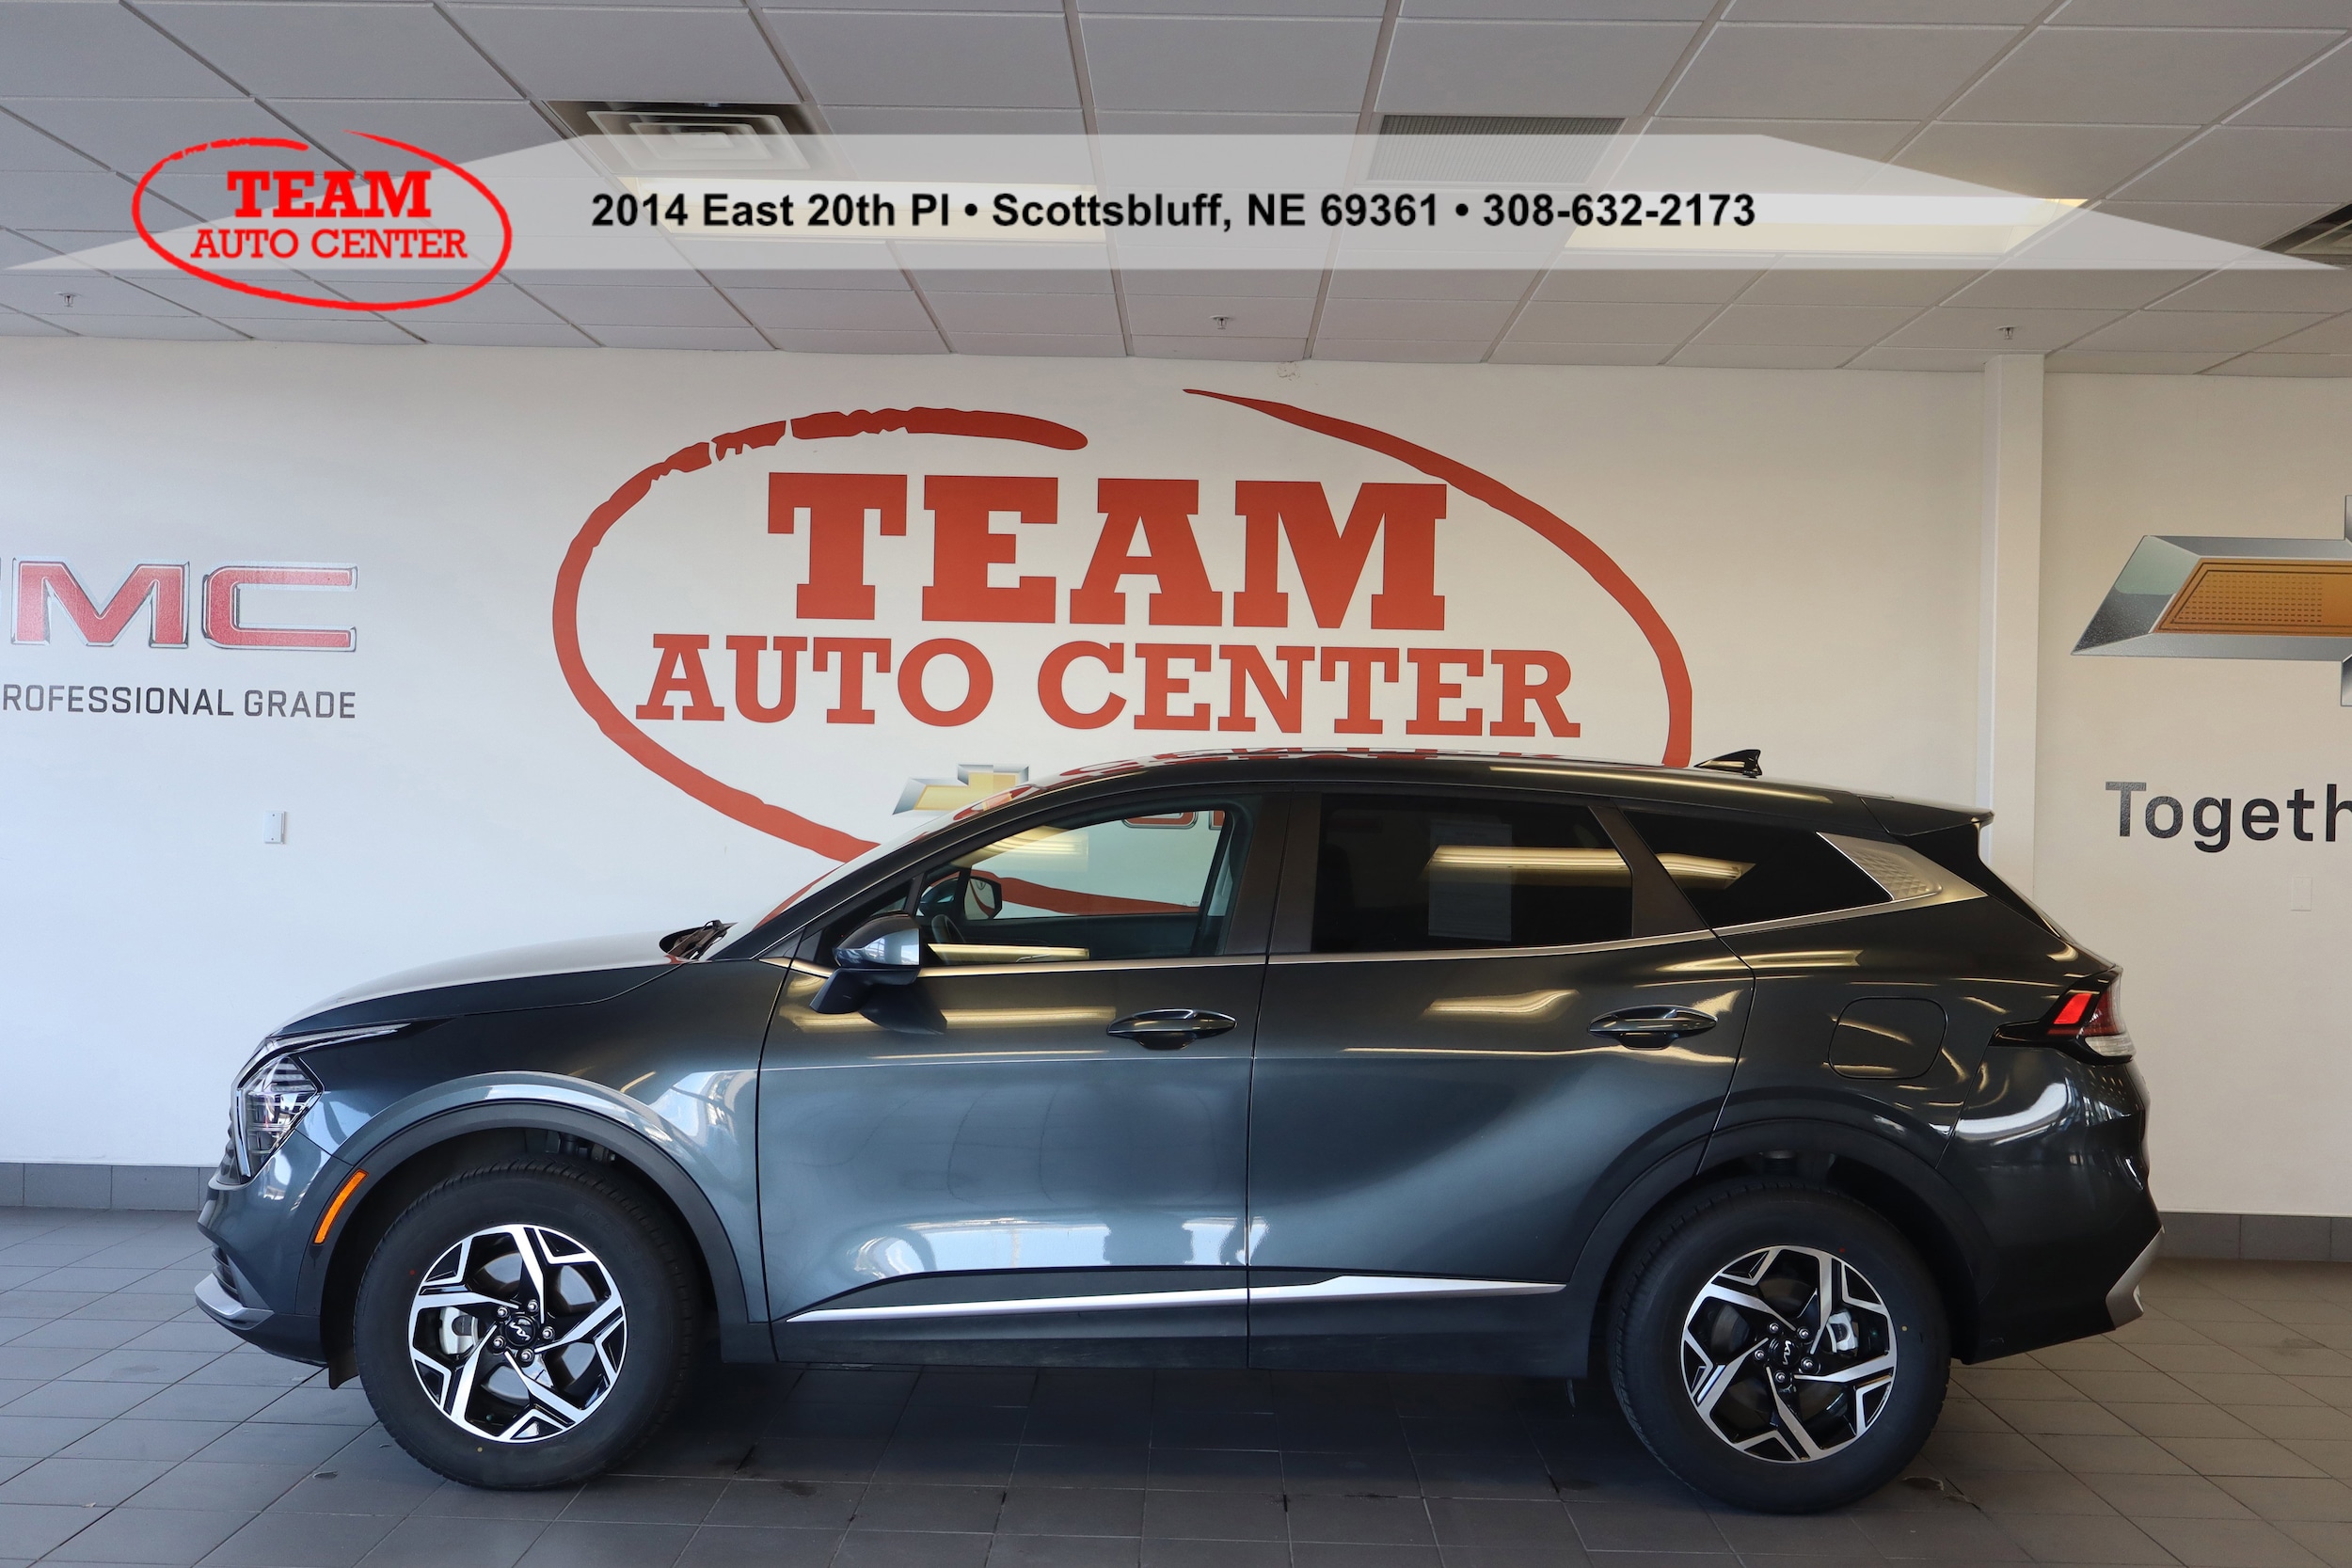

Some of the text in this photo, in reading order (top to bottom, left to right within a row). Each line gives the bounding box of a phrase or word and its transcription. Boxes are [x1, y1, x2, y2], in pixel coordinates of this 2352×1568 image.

[767, 472, 1447, 631] TEAM
[0, 556, 358, 652] MC
[244, 689, 357, 719] GRADE
[635, 633, 1581, 738] AUTO CENTER
